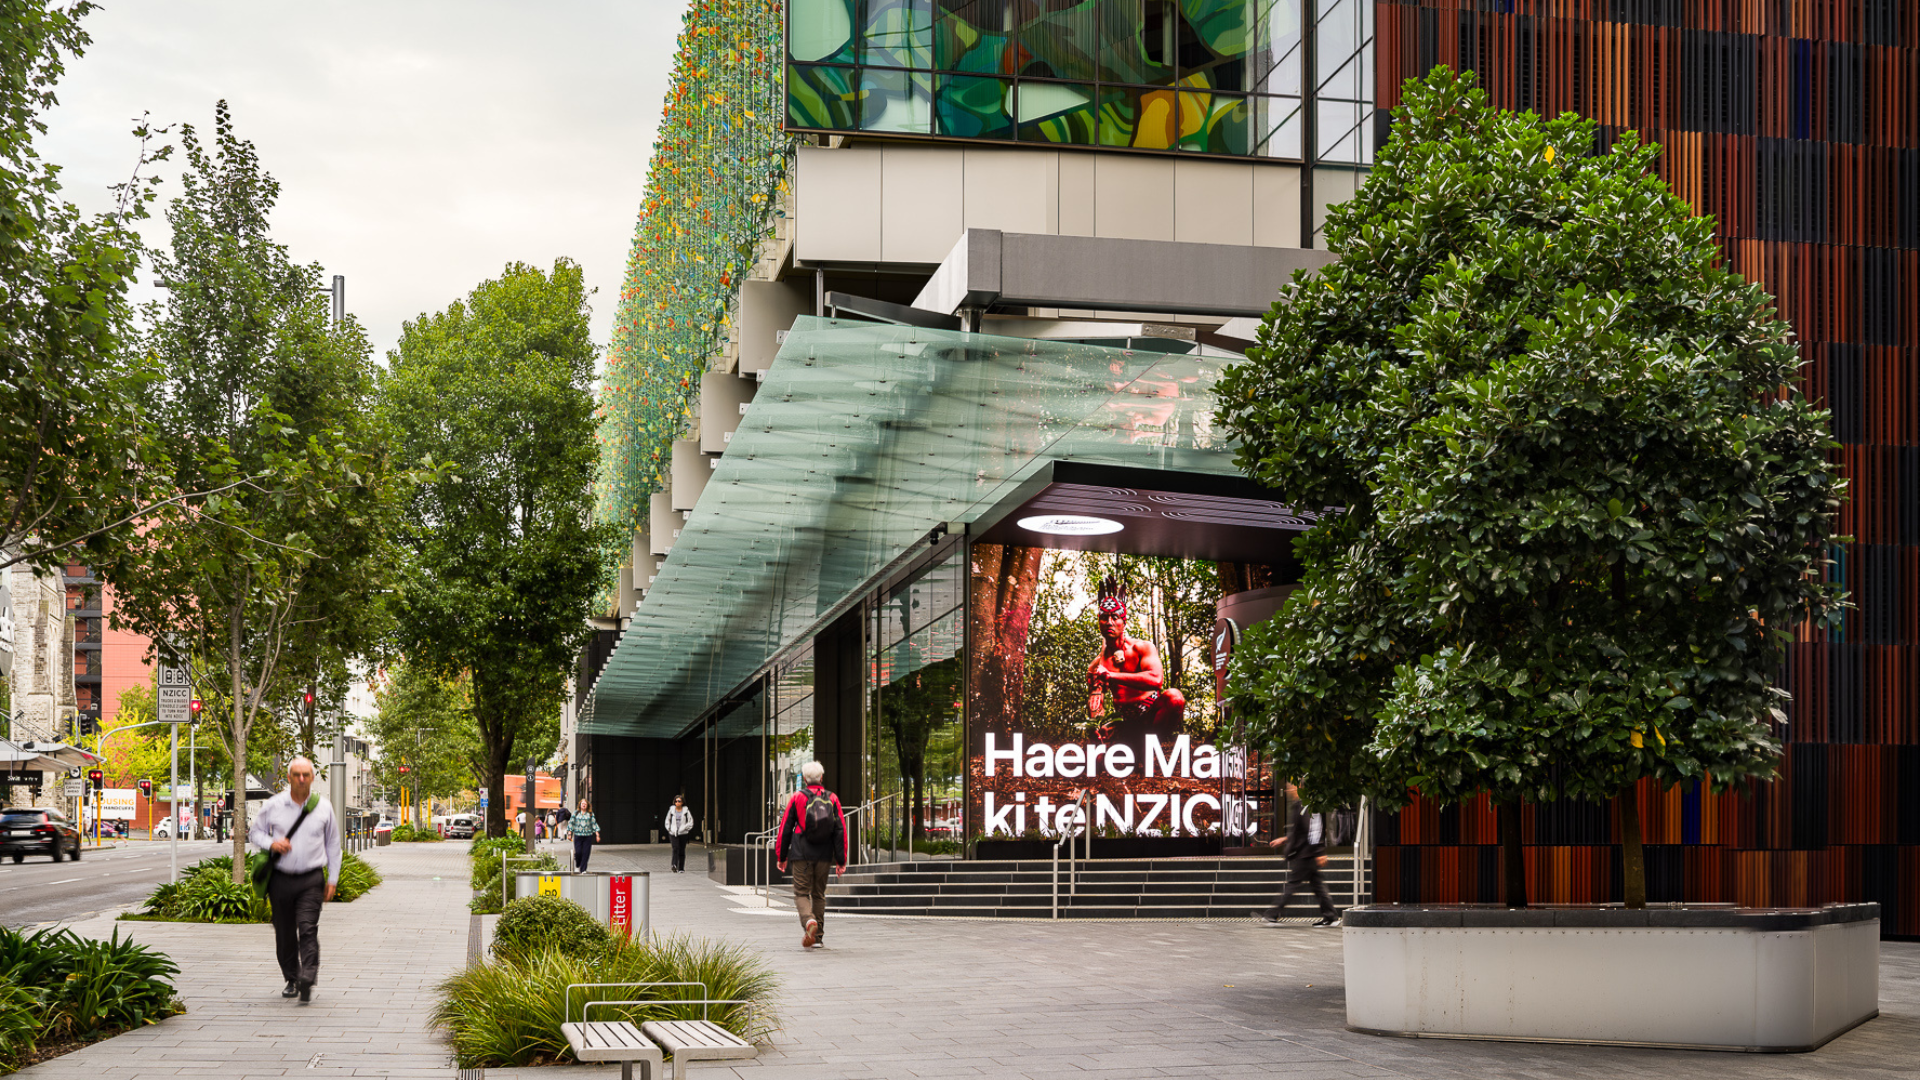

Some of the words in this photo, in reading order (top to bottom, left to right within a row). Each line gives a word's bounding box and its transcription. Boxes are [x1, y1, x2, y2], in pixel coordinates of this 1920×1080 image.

[163, 689, 187, 697] NZICC
[984, 732, 1136, 778] Haere
[984, 791, 1026, 837] ki
[1033, 796, 1087, 837] te
